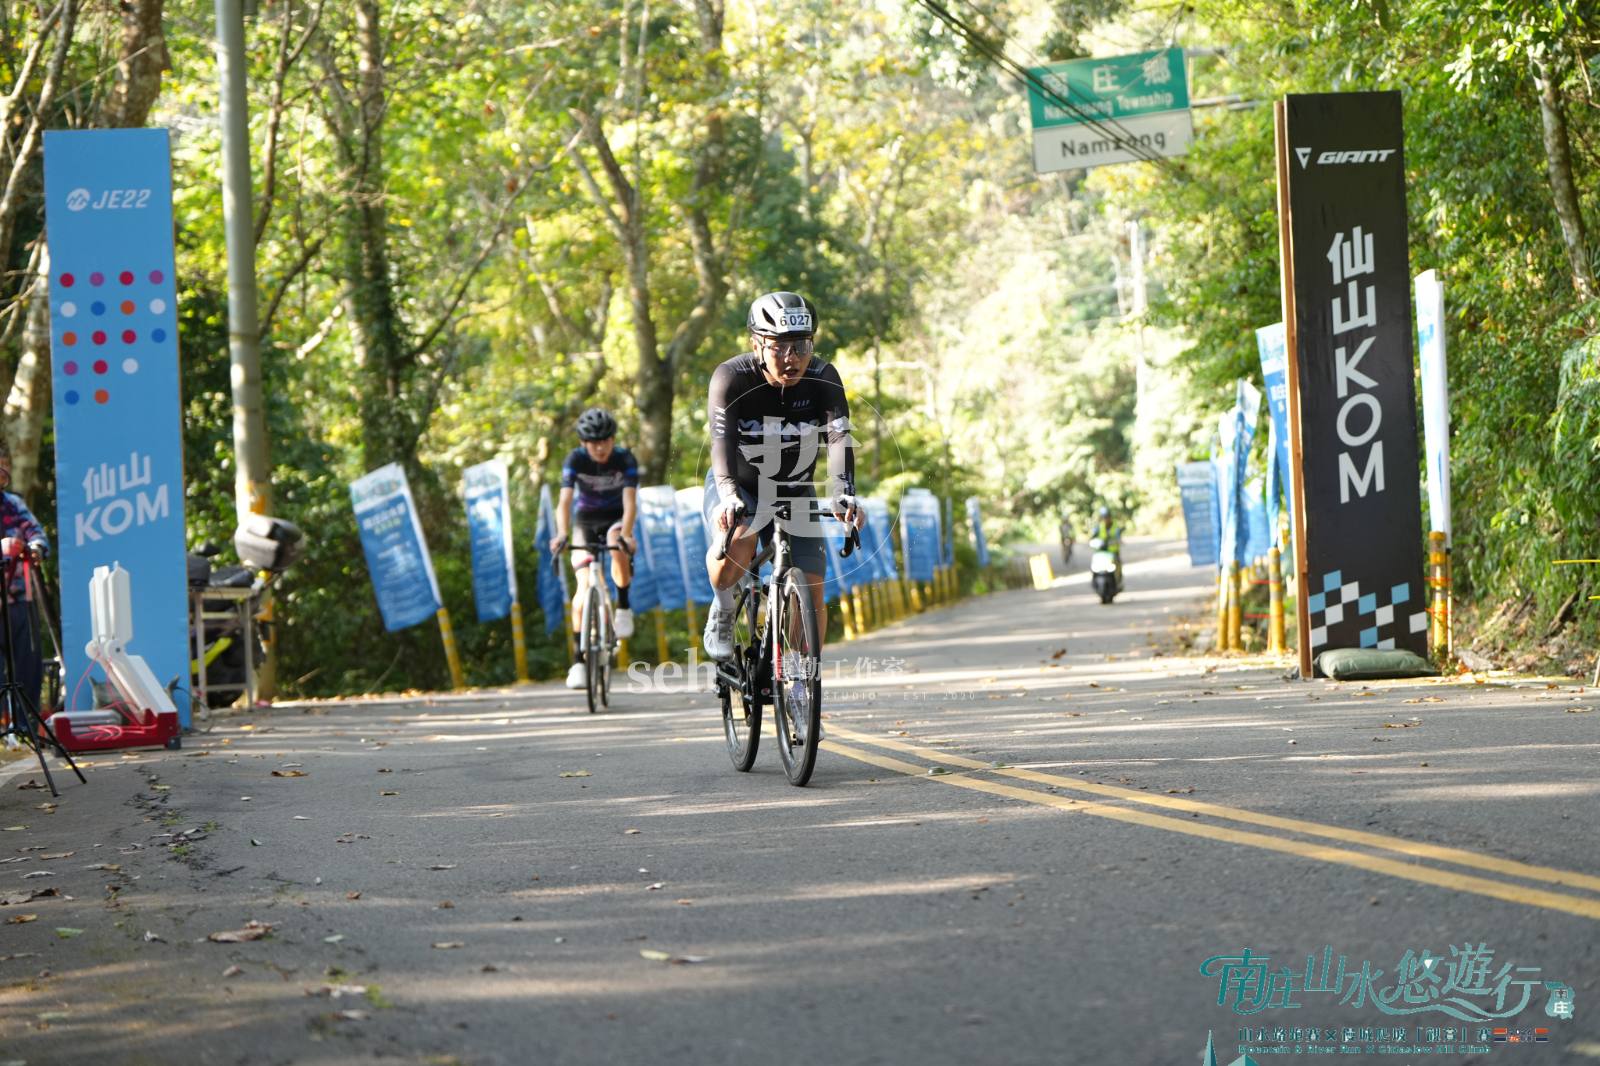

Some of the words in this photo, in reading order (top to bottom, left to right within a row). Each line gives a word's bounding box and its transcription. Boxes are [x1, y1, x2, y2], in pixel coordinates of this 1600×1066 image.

[1116, 91, 1174, 111] Township
[1317, 149, 1396, 165] GIANT
[92, 188, 152, 210] JE22
[82, 451, 152, 505] 仙山
[75, 484, 169, 547] KOM
